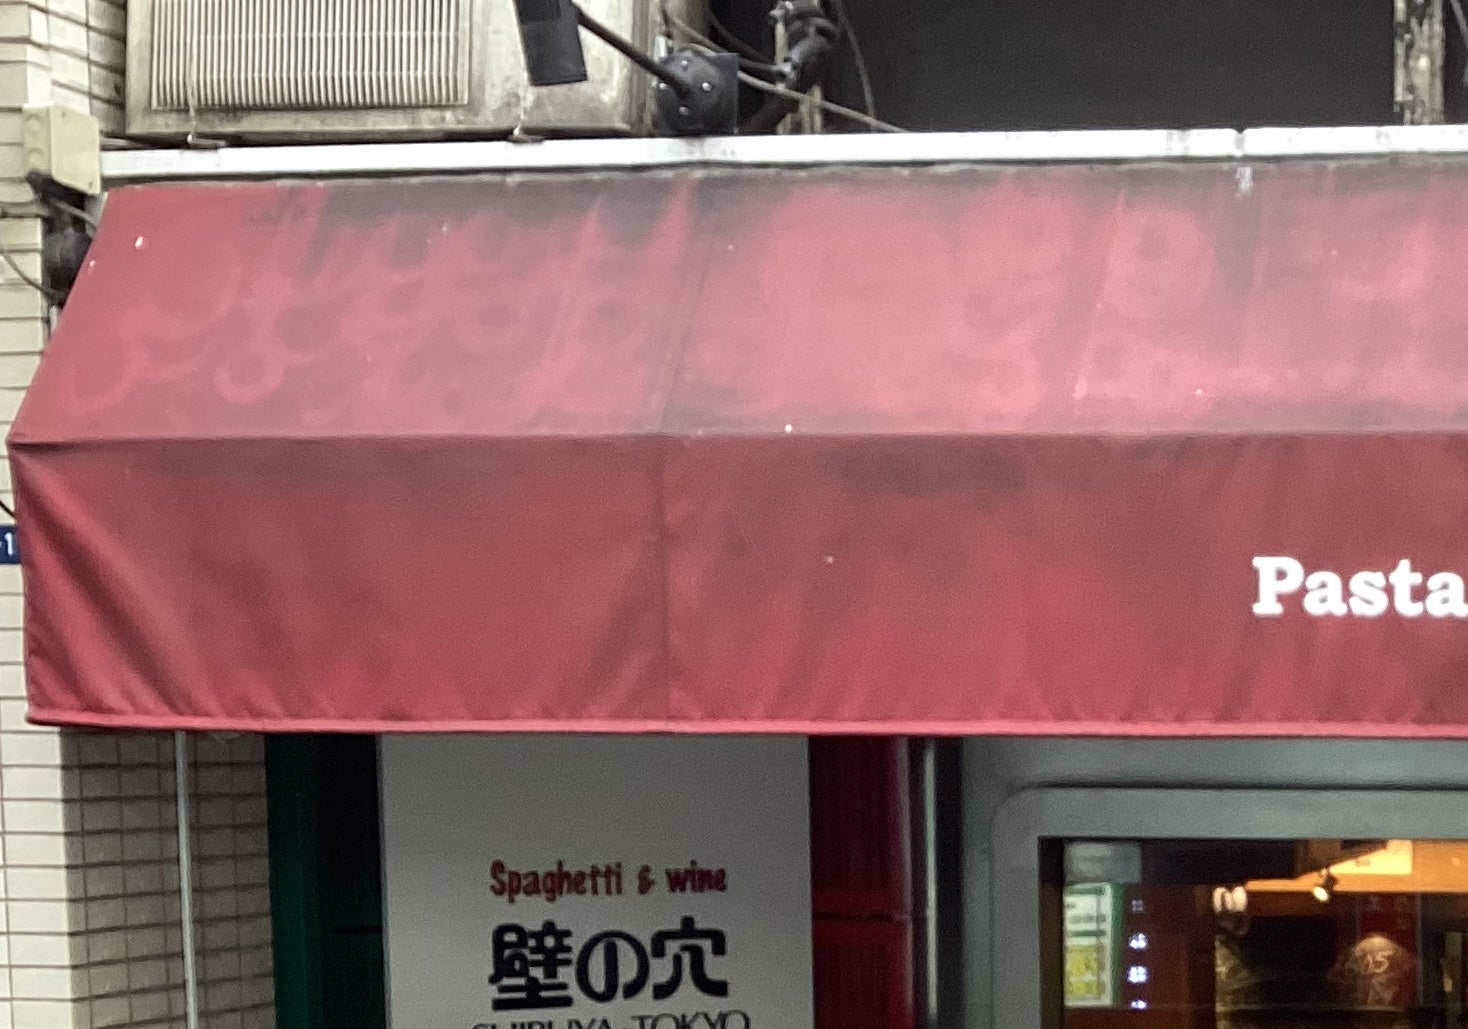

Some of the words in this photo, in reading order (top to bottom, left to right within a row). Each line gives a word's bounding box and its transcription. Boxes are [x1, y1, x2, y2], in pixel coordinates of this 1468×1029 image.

[489, 859, 624, 903] Spaghetti
[665, 859, 728, 893] wine
[488, 915, 729, 1012] 壁の穴
